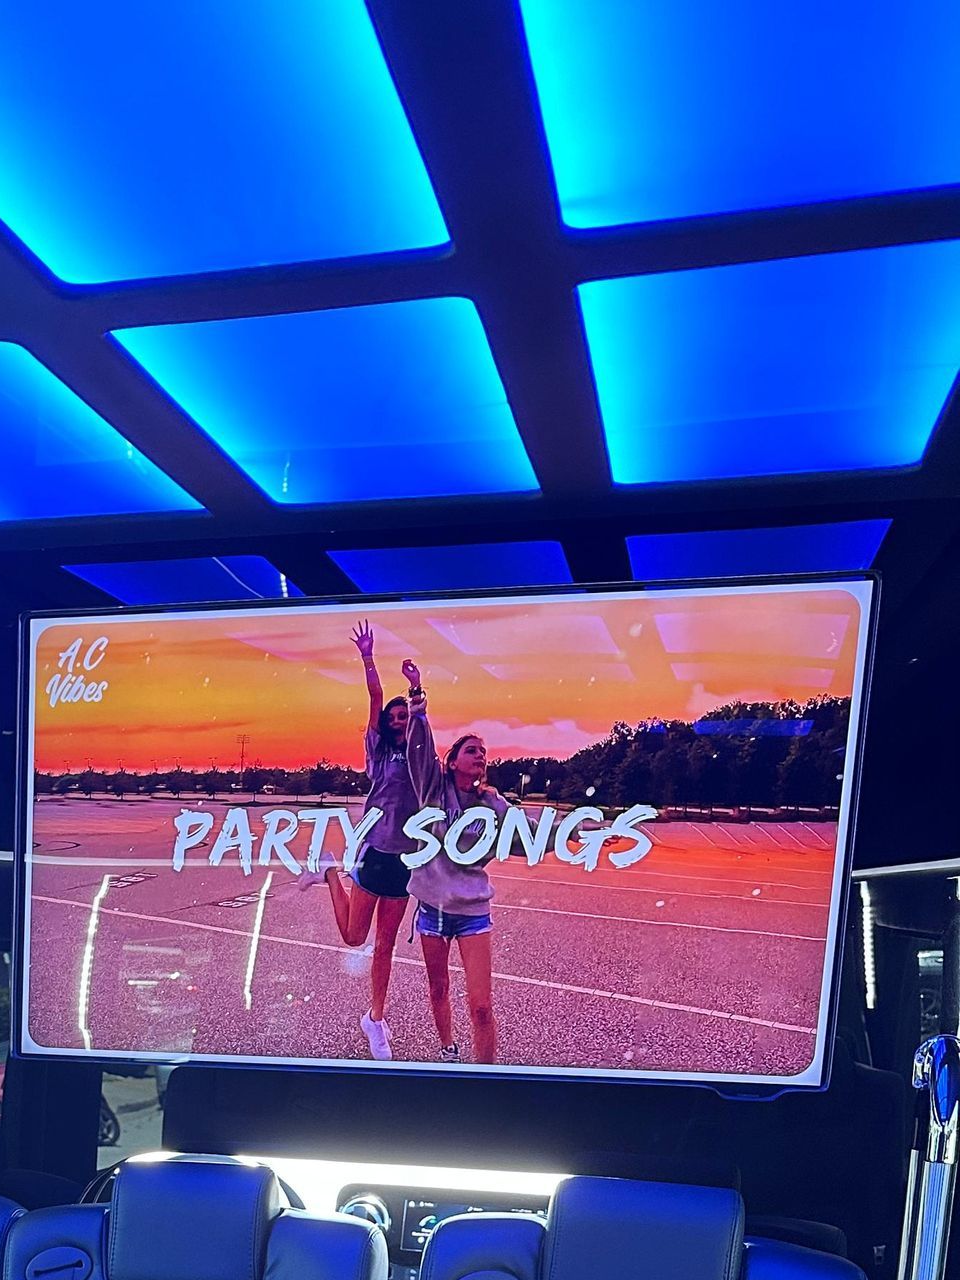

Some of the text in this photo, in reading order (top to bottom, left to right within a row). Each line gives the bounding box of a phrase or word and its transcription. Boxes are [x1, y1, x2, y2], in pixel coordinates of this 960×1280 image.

[58, 637, 109, 672] A.C
[46, 674, 108, 707] Vibes
[173, 807, 384, 876] PARTY
[400, 804, 658, 872] SONGS
